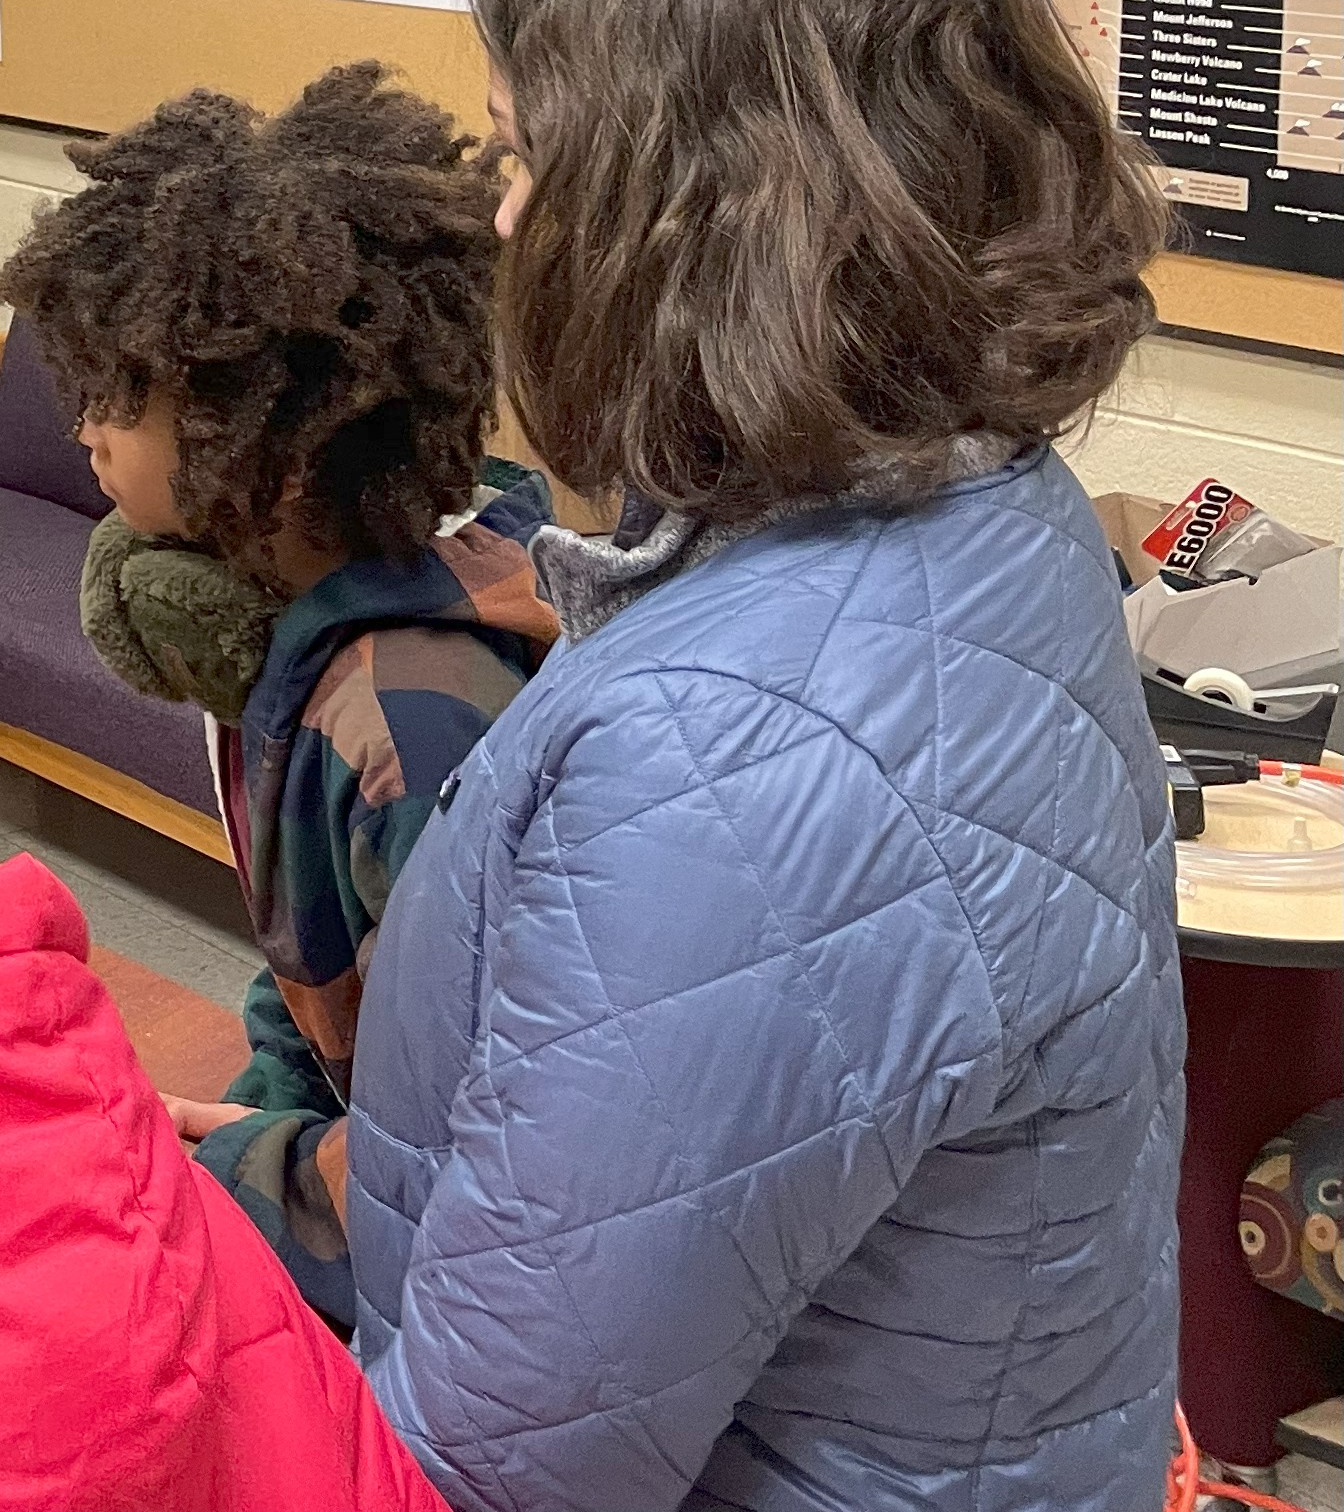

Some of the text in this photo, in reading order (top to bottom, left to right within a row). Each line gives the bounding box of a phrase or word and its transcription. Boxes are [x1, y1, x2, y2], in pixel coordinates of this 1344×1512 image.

[1153, 10, 1233, 29] Mount Jefferson
[1152, 29, 1218, 48] Three Sisters
[1151, 49, 1243, 70] Newberry Volcano
[1150, 68, 1208, 86] Crater Lake
[1150, 88, 1266, 113] Medicine Lake Volcano
[1149, 107, 1218, 127] Mount Shasta
[1149, 126, 1211, 145] Lassen Peak
[1165, 484, 1234, 570] E6000
